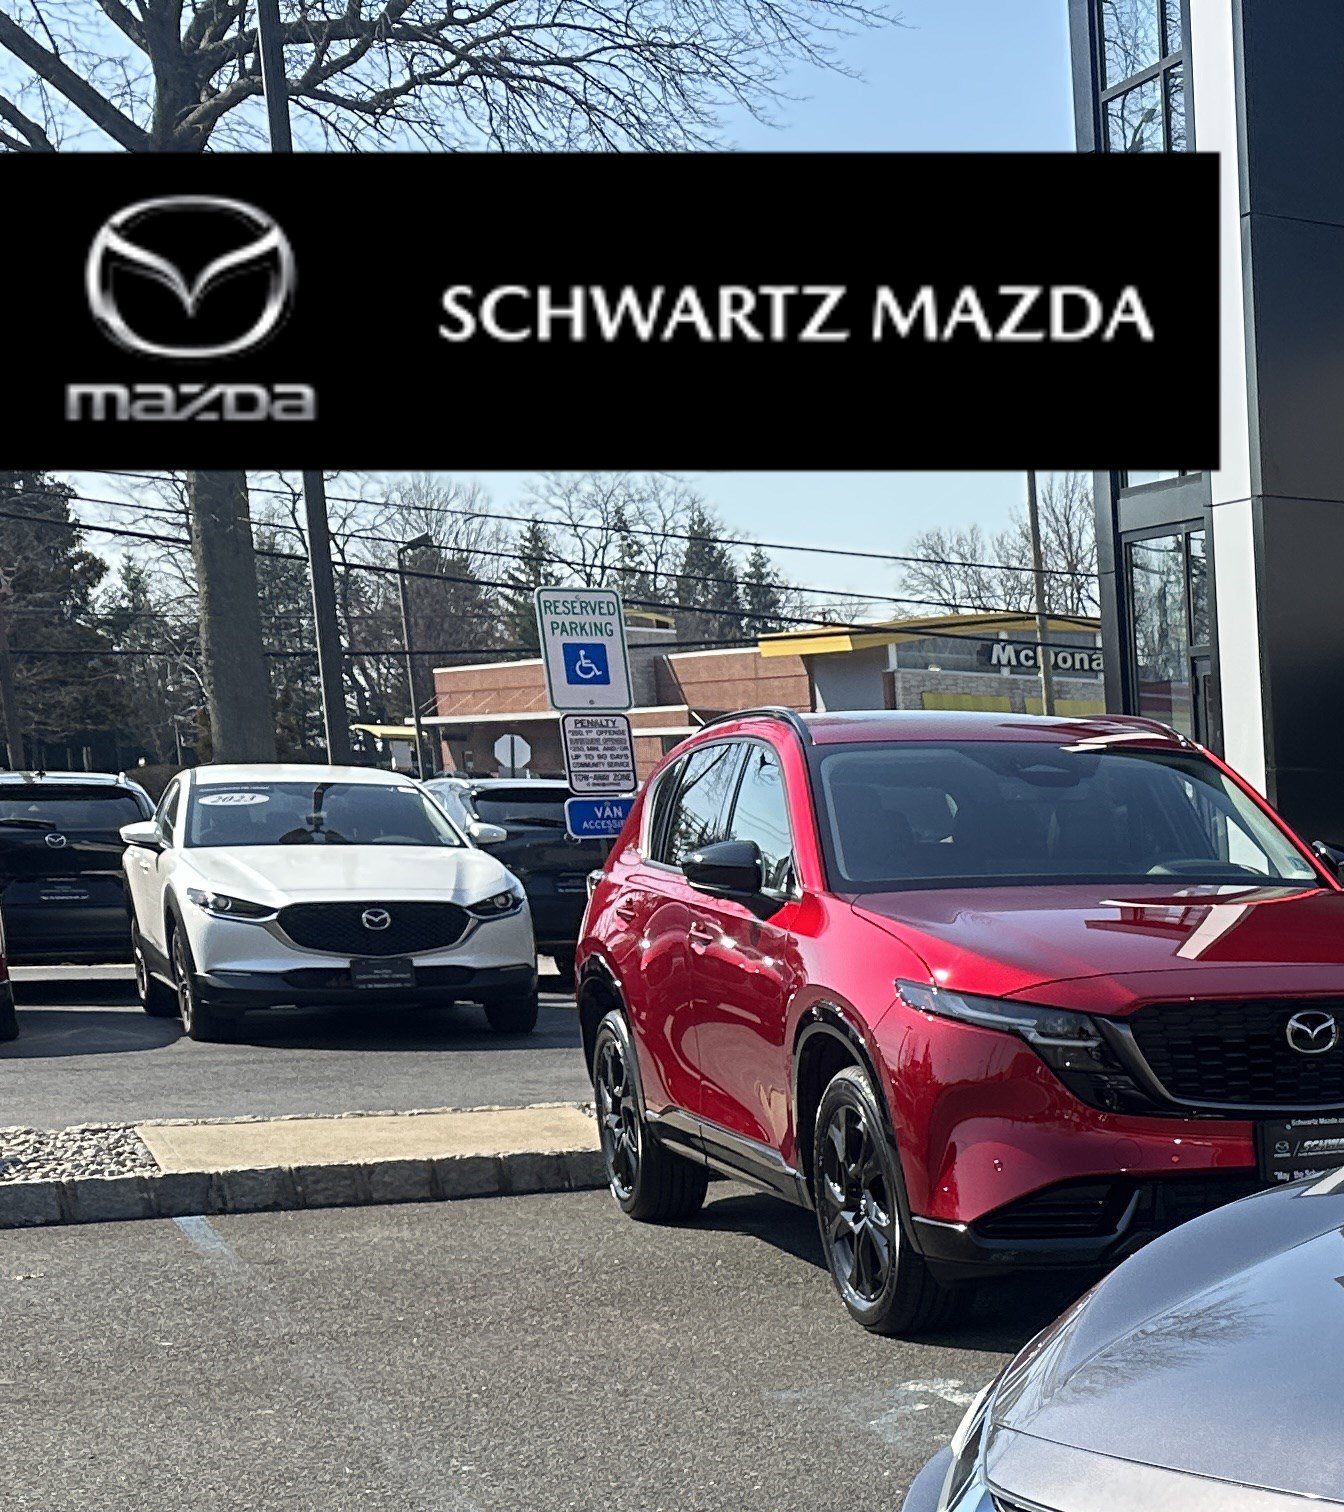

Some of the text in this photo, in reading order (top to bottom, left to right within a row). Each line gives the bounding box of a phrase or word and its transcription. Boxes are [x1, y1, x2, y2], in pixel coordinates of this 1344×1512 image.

[543, 600, 616, 616] RESERVED
[550, 621, 614, 637] PARKING
[574, 719, 618, 728] PENALTY
[594, 806, 623, 818] VAN
[582, 820, 625, 829] ACCESSI
